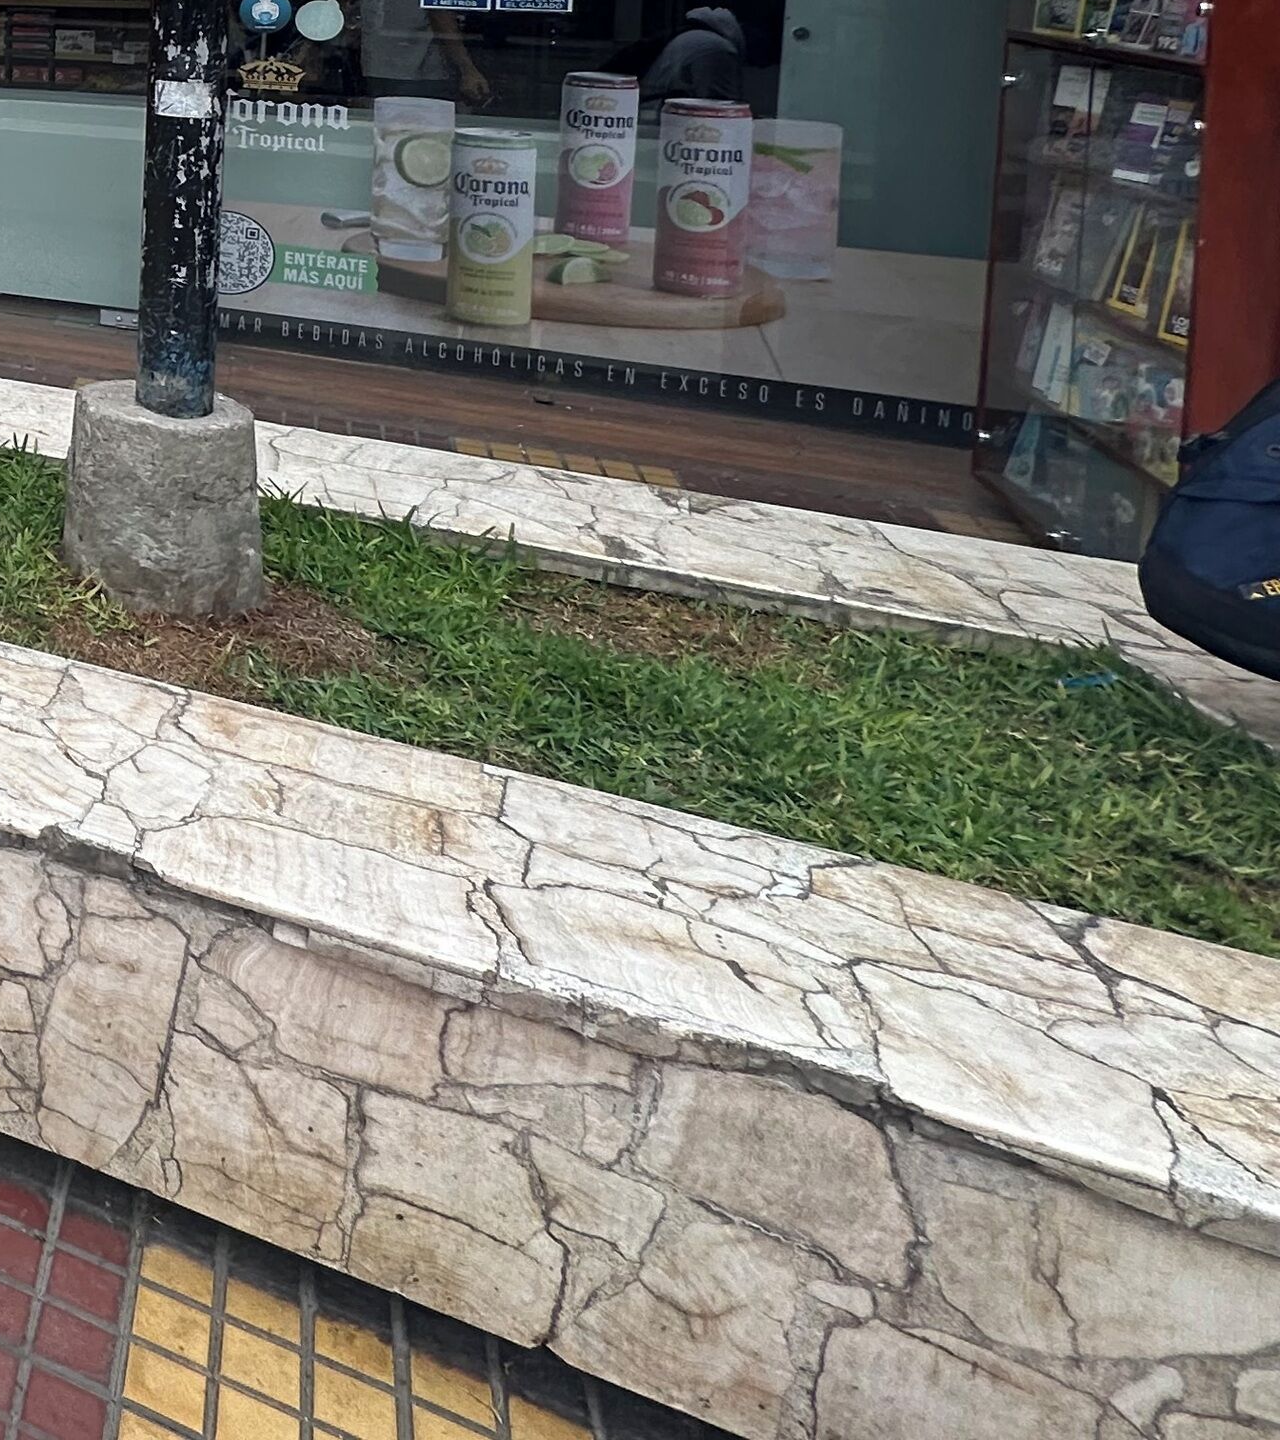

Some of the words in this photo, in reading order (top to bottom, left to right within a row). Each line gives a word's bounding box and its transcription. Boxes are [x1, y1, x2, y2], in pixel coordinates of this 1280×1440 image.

[566, 109, 634, 131] Corona
[232, 126, 325, 152] Tropical
[581, 129, 626, 140] Tropical
[663, 139, 744, 165] Corona
[680, 163, 733, 176] Tropical
[454, 172, 531, 197] Corona
[469, 195, 519, 208] Tropical
[284, 249, 368, 273] ENTÉRATE
[283, 267, 319, 284] MÁS
[323, 272, 363, 290] AQUÍ
[282, 320, 383, 350] BEBIDAS
[404, 337, 583, 378] ALCOHÓLICAS
[607, 365, 635, 385] EN
[660, 371, 769, 403] EXCESO
[795, 389, 826, 411] ES
[853, 396, 973, 432] DAÑINO
